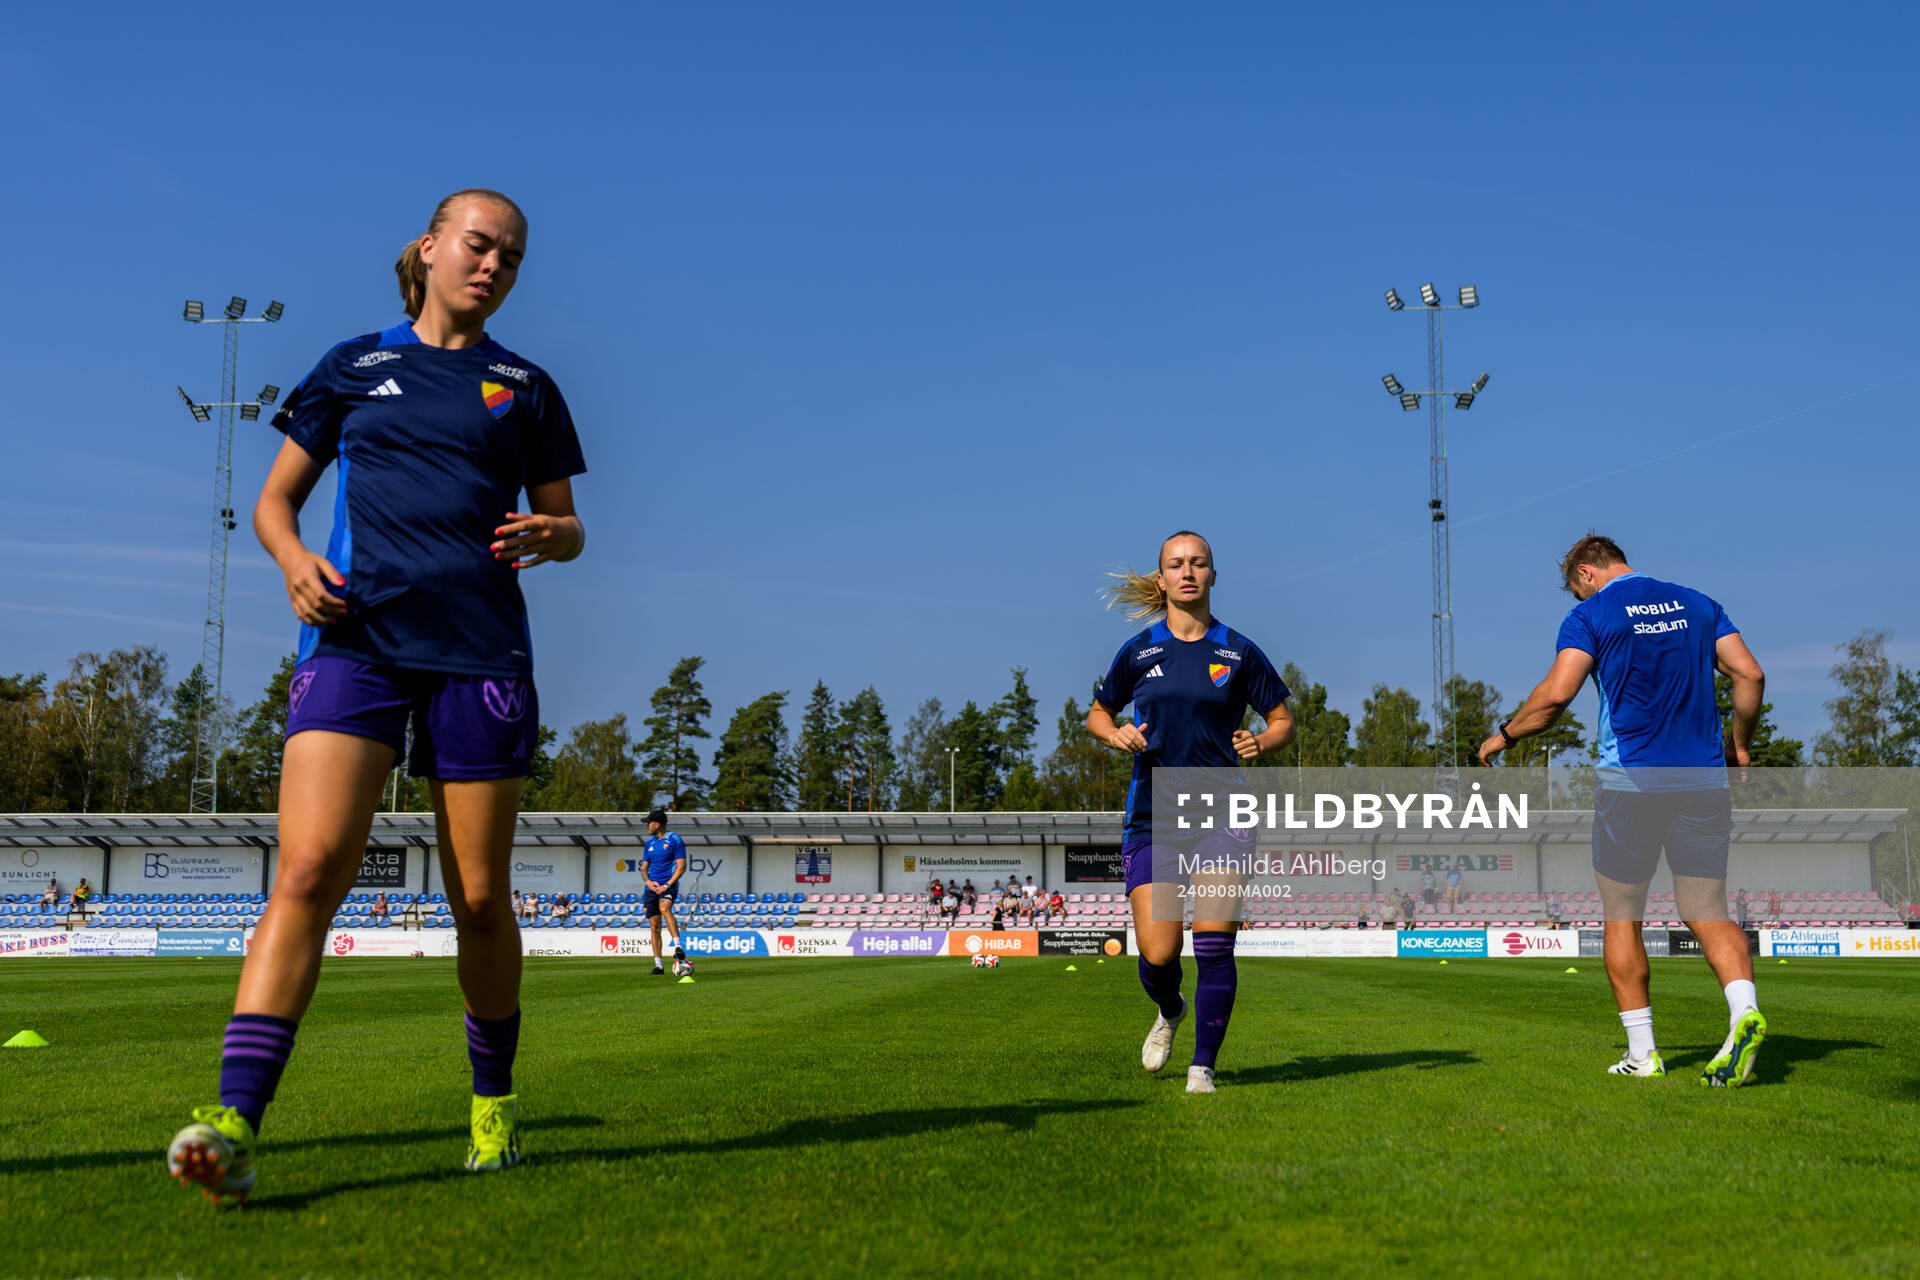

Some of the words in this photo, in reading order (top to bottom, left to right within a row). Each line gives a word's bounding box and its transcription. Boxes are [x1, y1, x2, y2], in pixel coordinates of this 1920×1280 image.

[1625, 600, 1684, 617] MOBILL
[1633, 618, 1689, 634] stadium
[919, 856, 978, 866] Hässleholms
[979, 857, 1022, 866] kommun
[1408, 854, 1500, 872] PEAB
[514, 862, 555, 874] Omsorg
[1, 871, 58, 879] SUNLIGHT
[29, 933, 69, 950] BUSS
[984, 938, 1022, 950] HIBAB
[1401, 937, 1485, 949] KONECRANES
[1525, 937, 1563, 950] VIDA
[1771, 931, 1788, 941] Bo
[1791, 931, 1839, 944] Ahlquist
[686, 936, 723, 953] Heja
[724, 936, 756, 953] dig!
[863, 936, 900, 953] Heja
[901, 936, 933, 951] alla!
[1776, 945, 1819, 954] MASKIN
[1821, 945, 1836, 954] AB
